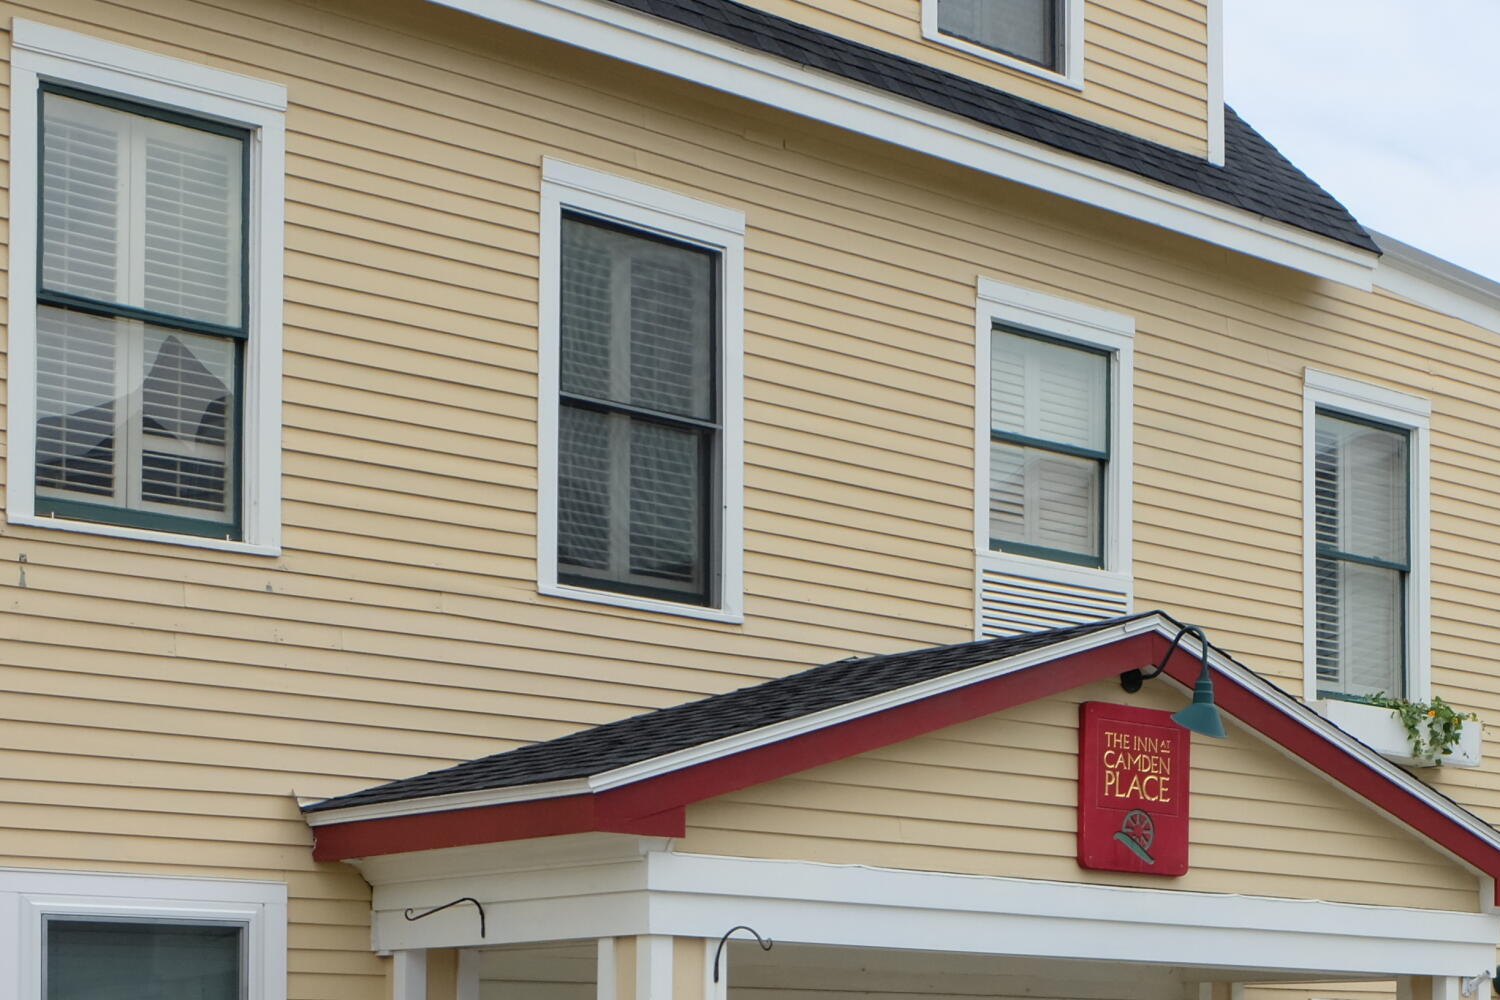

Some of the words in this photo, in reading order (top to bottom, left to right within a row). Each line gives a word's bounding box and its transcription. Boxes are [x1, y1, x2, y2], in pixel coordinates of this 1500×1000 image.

[1104, 732, 1130, 749] THE
[1133, 736, 1158, 753] INN
[1160, 740, 1171, 752] AT
[1104, 750, 1171, 775] CAMDEN
[1104, 770, 1171, 803] PLACE
